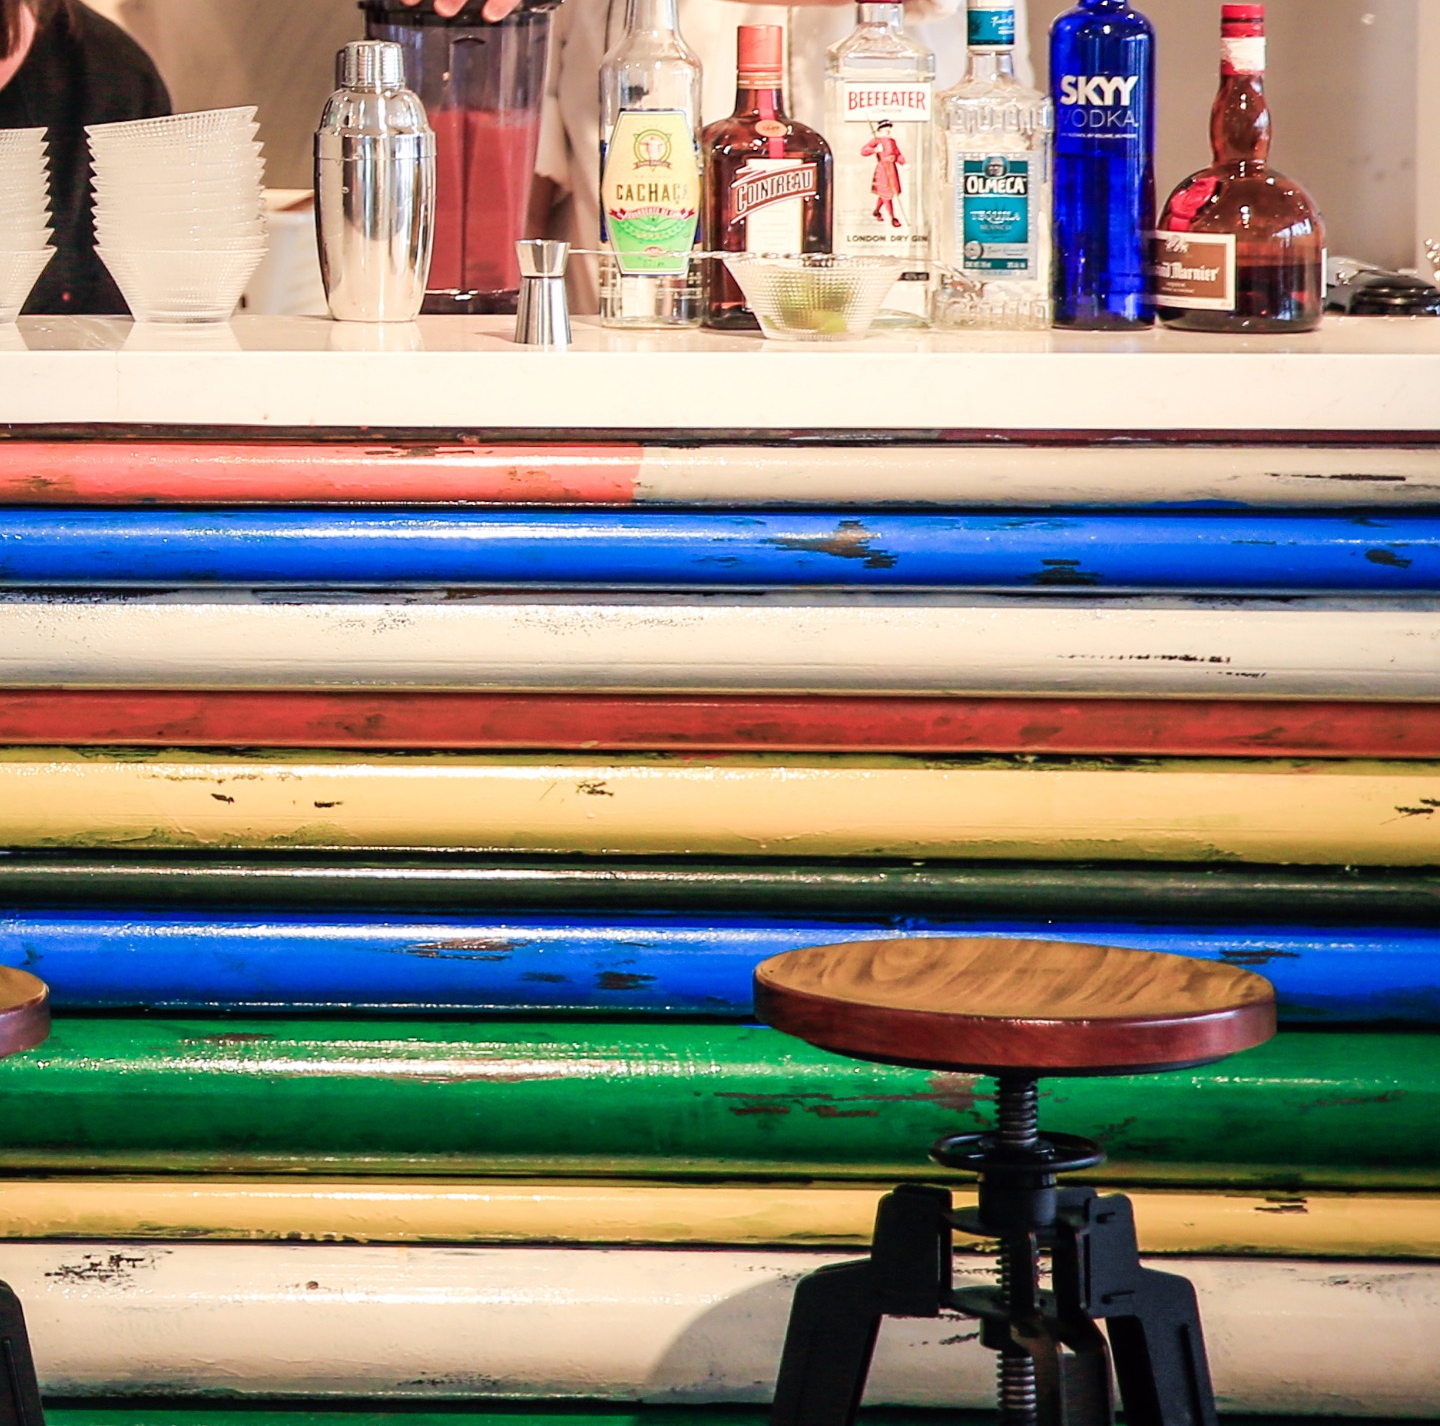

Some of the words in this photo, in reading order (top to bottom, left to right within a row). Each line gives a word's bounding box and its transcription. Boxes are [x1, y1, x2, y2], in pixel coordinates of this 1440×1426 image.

[848, 91, 926, 111] BEEFEATER
[1060, 74, 1139, 106] SKYY
[736, 169, 815, 216] COINTREAU
[966, 175, 1025, 194] OLMECA
